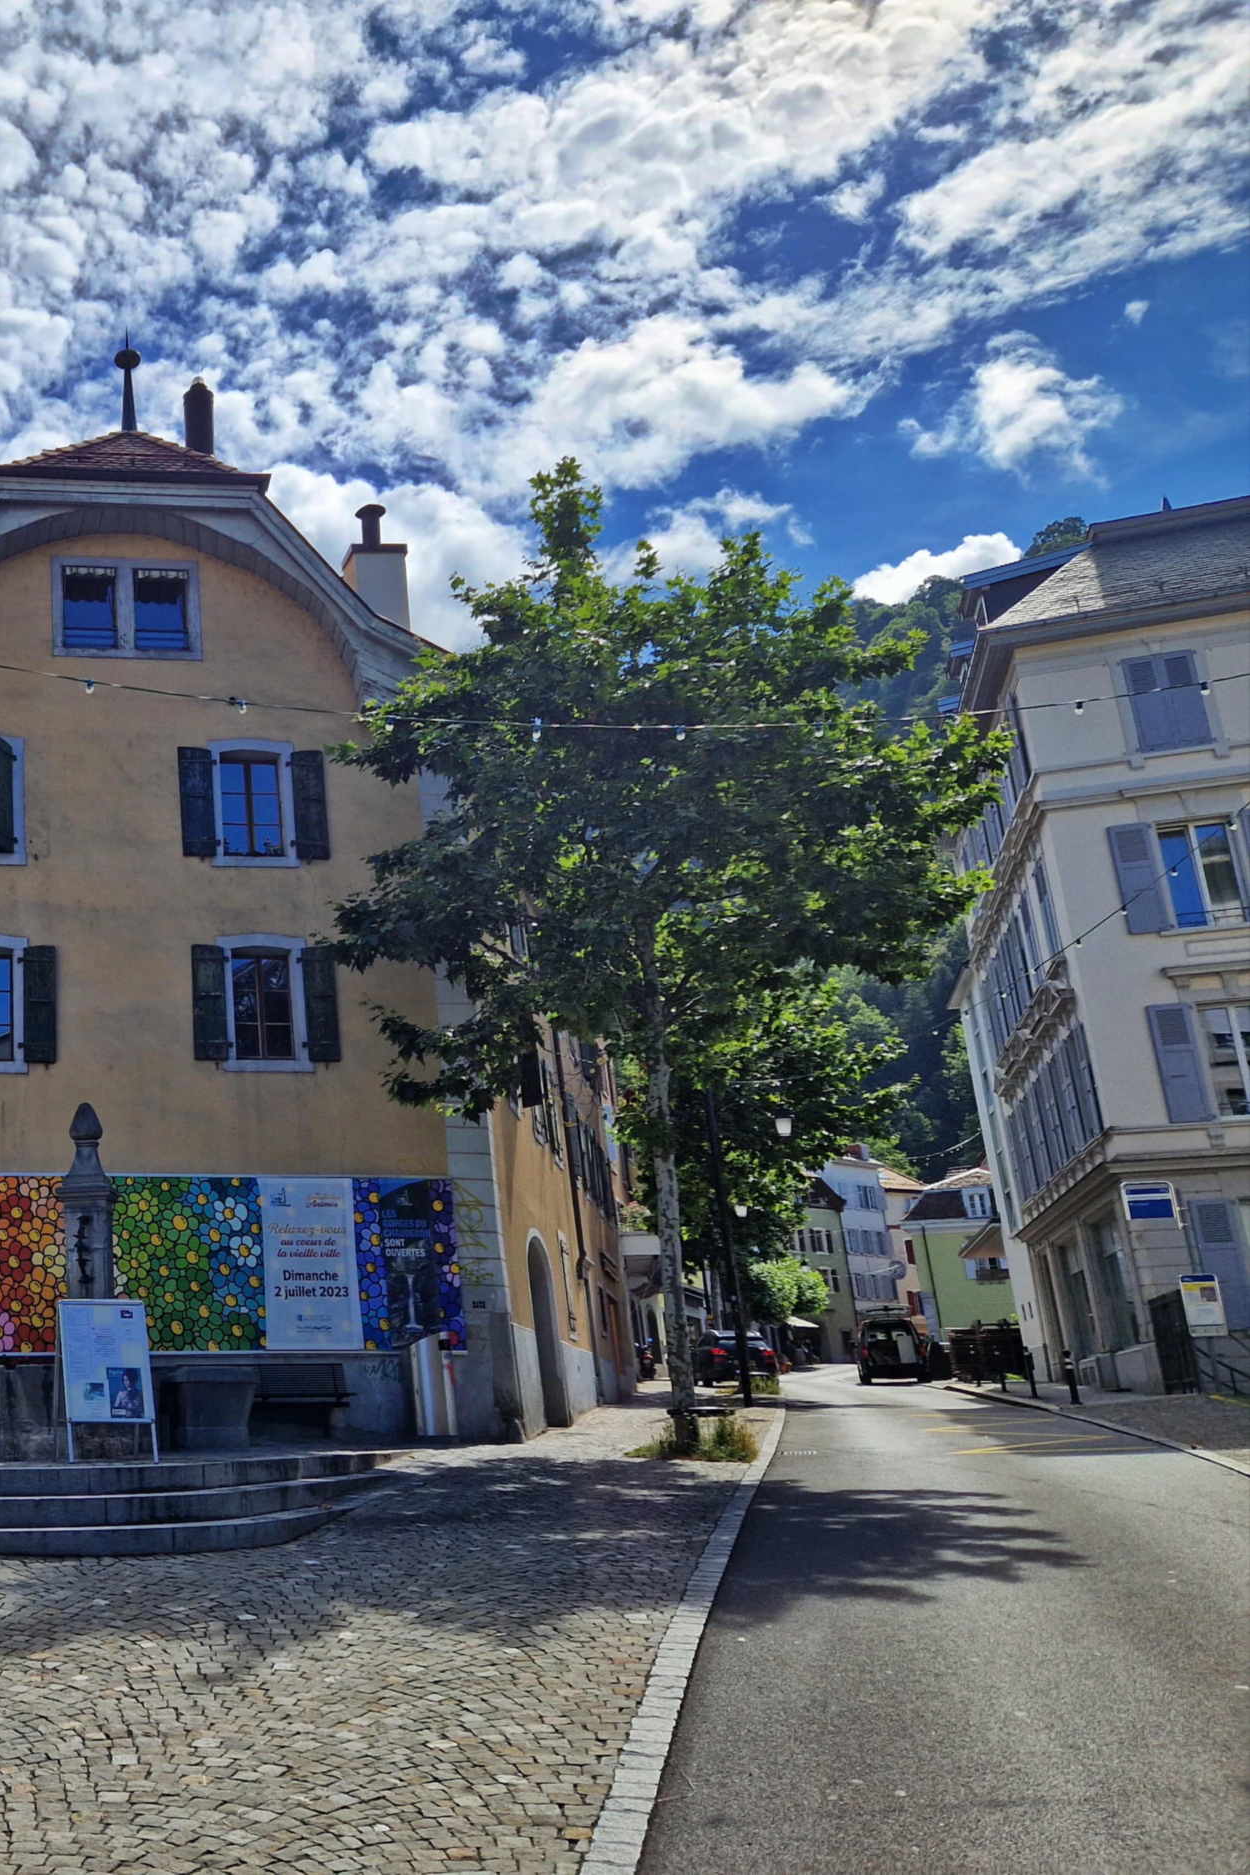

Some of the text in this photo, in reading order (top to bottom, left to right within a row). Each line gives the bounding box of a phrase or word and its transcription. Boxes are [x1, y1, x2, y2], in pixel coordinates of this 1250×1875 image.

[324, 1236, 336, 1246] de
[383, 1238, 406, 1247] SONT
[277, 1248, 342, 1258] la vieille ville
[385, 1247, 426, 1257] OUVERTES
[282, 1269, 339, 1281] Dimanche
[274, 1286, 349, 1300] 2 juillet 2023
